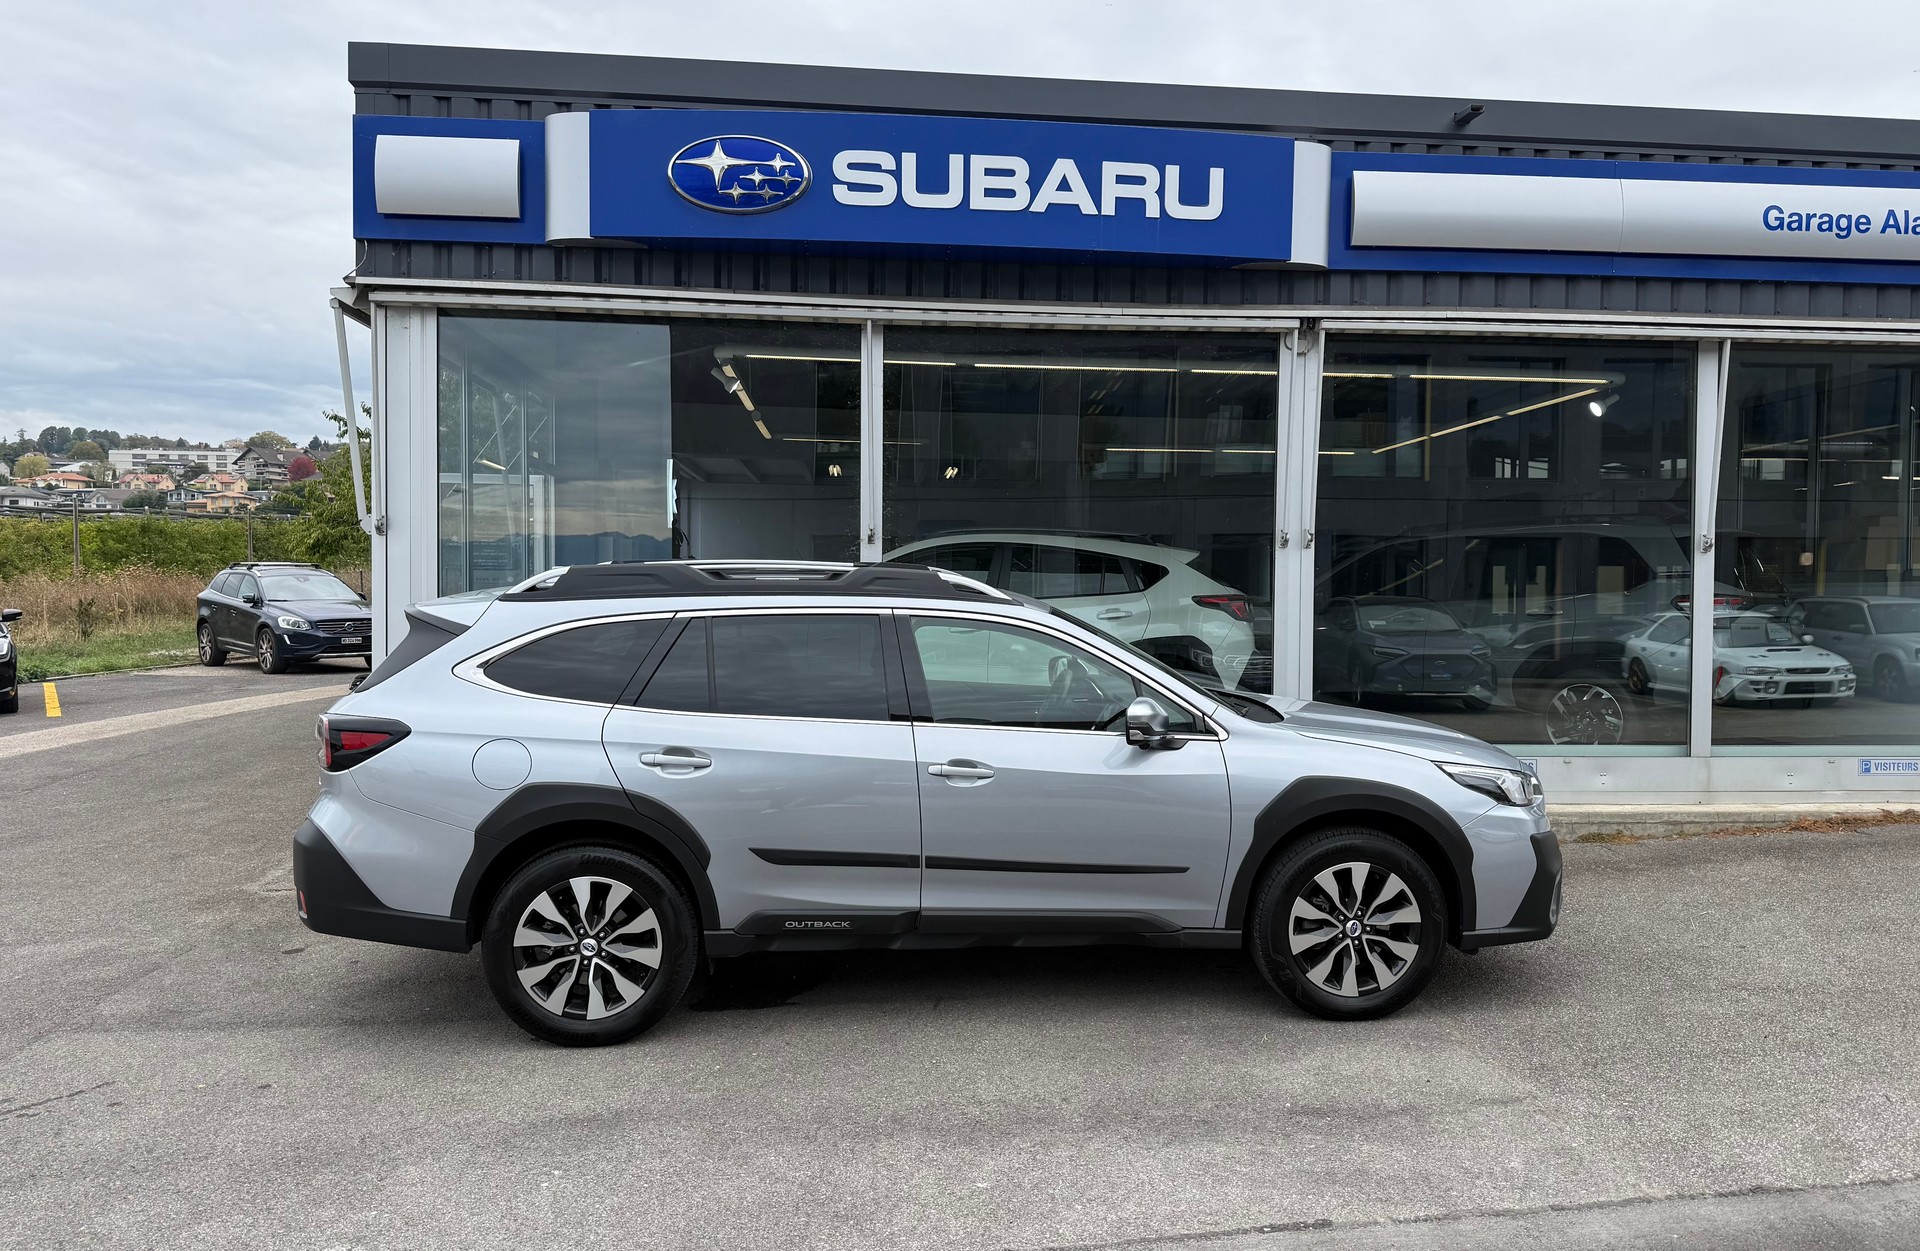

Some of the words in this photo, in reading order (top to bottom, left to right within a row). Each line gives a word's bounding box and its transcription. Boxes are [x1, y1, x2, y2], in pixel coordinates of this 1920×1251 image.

[832, 149, 1225, 221] SUBARU
[1763, 205, 1871, 239] Garage
[1874, 762, 1918, 771] VISITEURS
